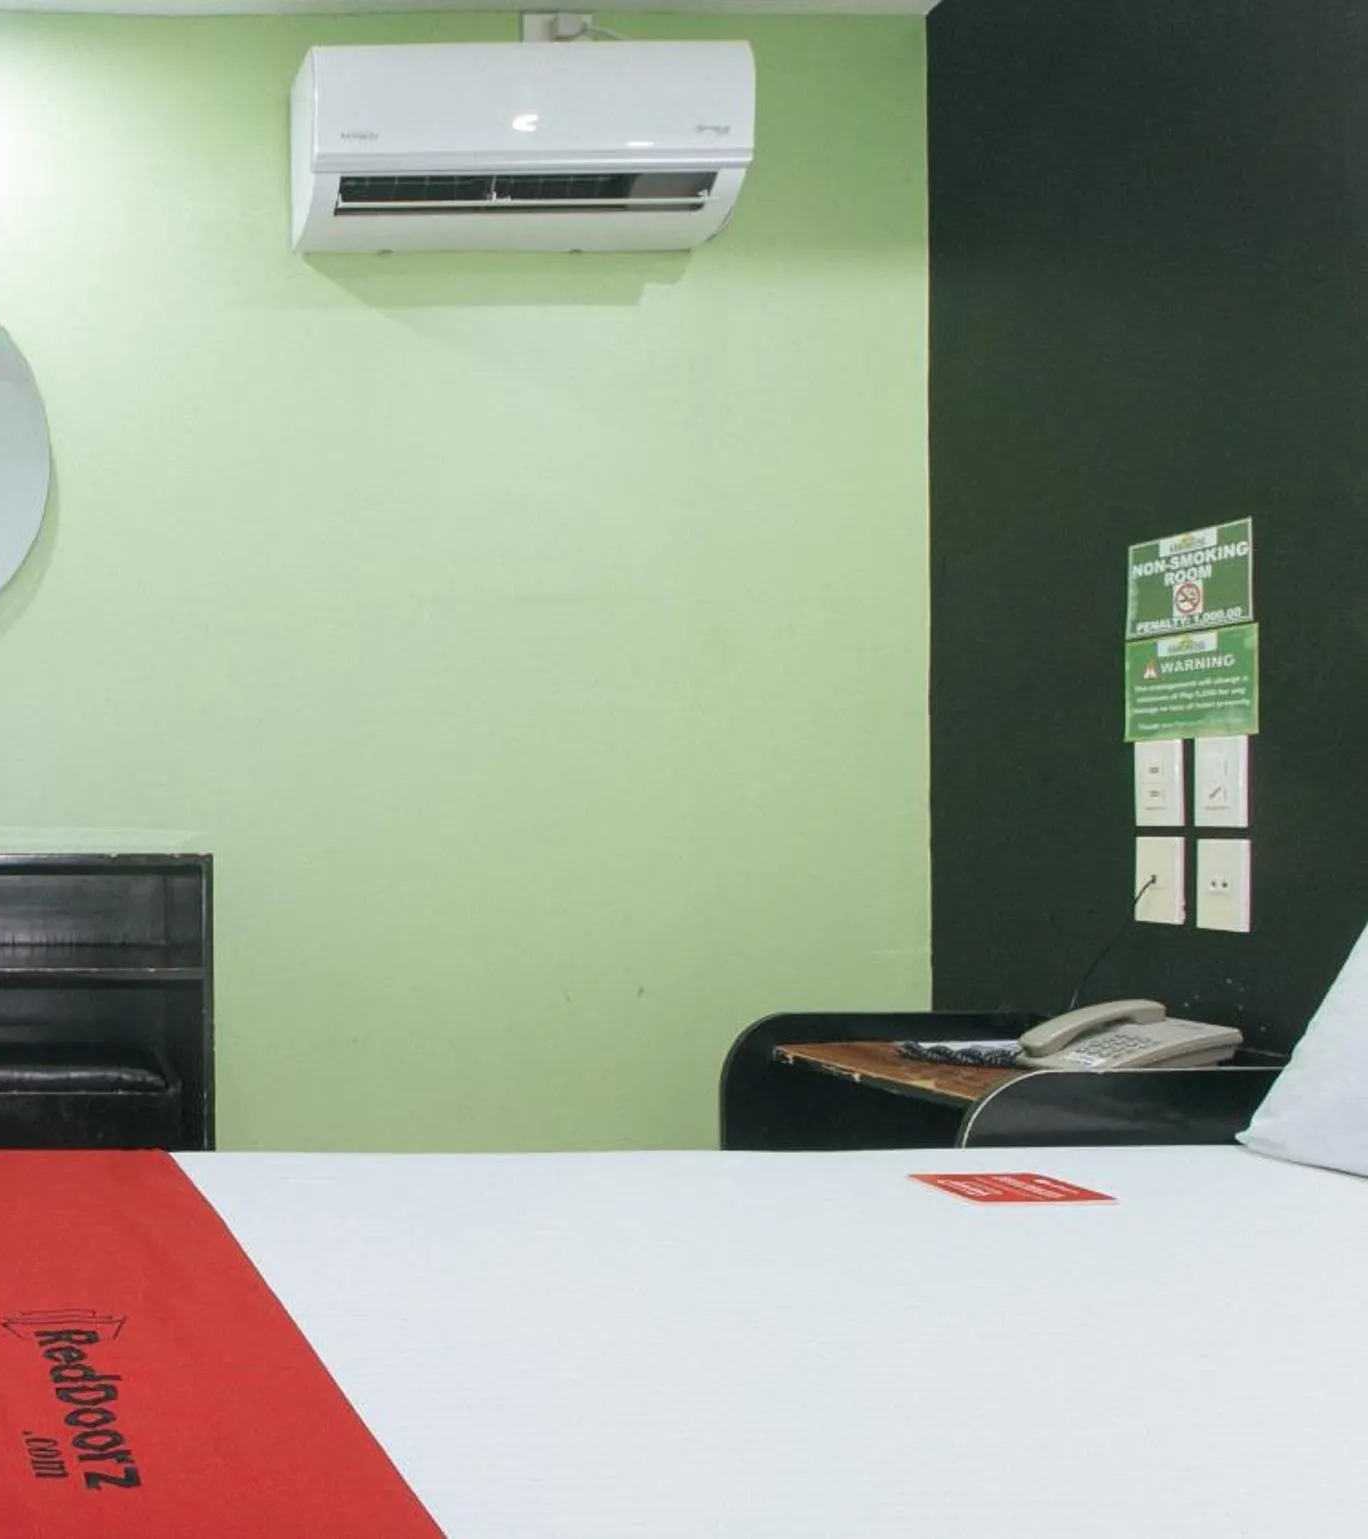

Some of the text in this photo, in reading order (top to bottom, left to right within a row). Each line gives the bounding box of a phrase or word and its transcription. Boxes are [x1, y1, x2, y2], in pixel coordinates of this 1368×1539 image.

[1131, 541, 1249, 577] NON-SMOKING
[1163, 564, 1213, 586] ROOM
[1160, 654, 1235, 673] WARNING
[34, 1329, 141, 1490] RedDoorz
[22, 1431, 69, 1478] .com
